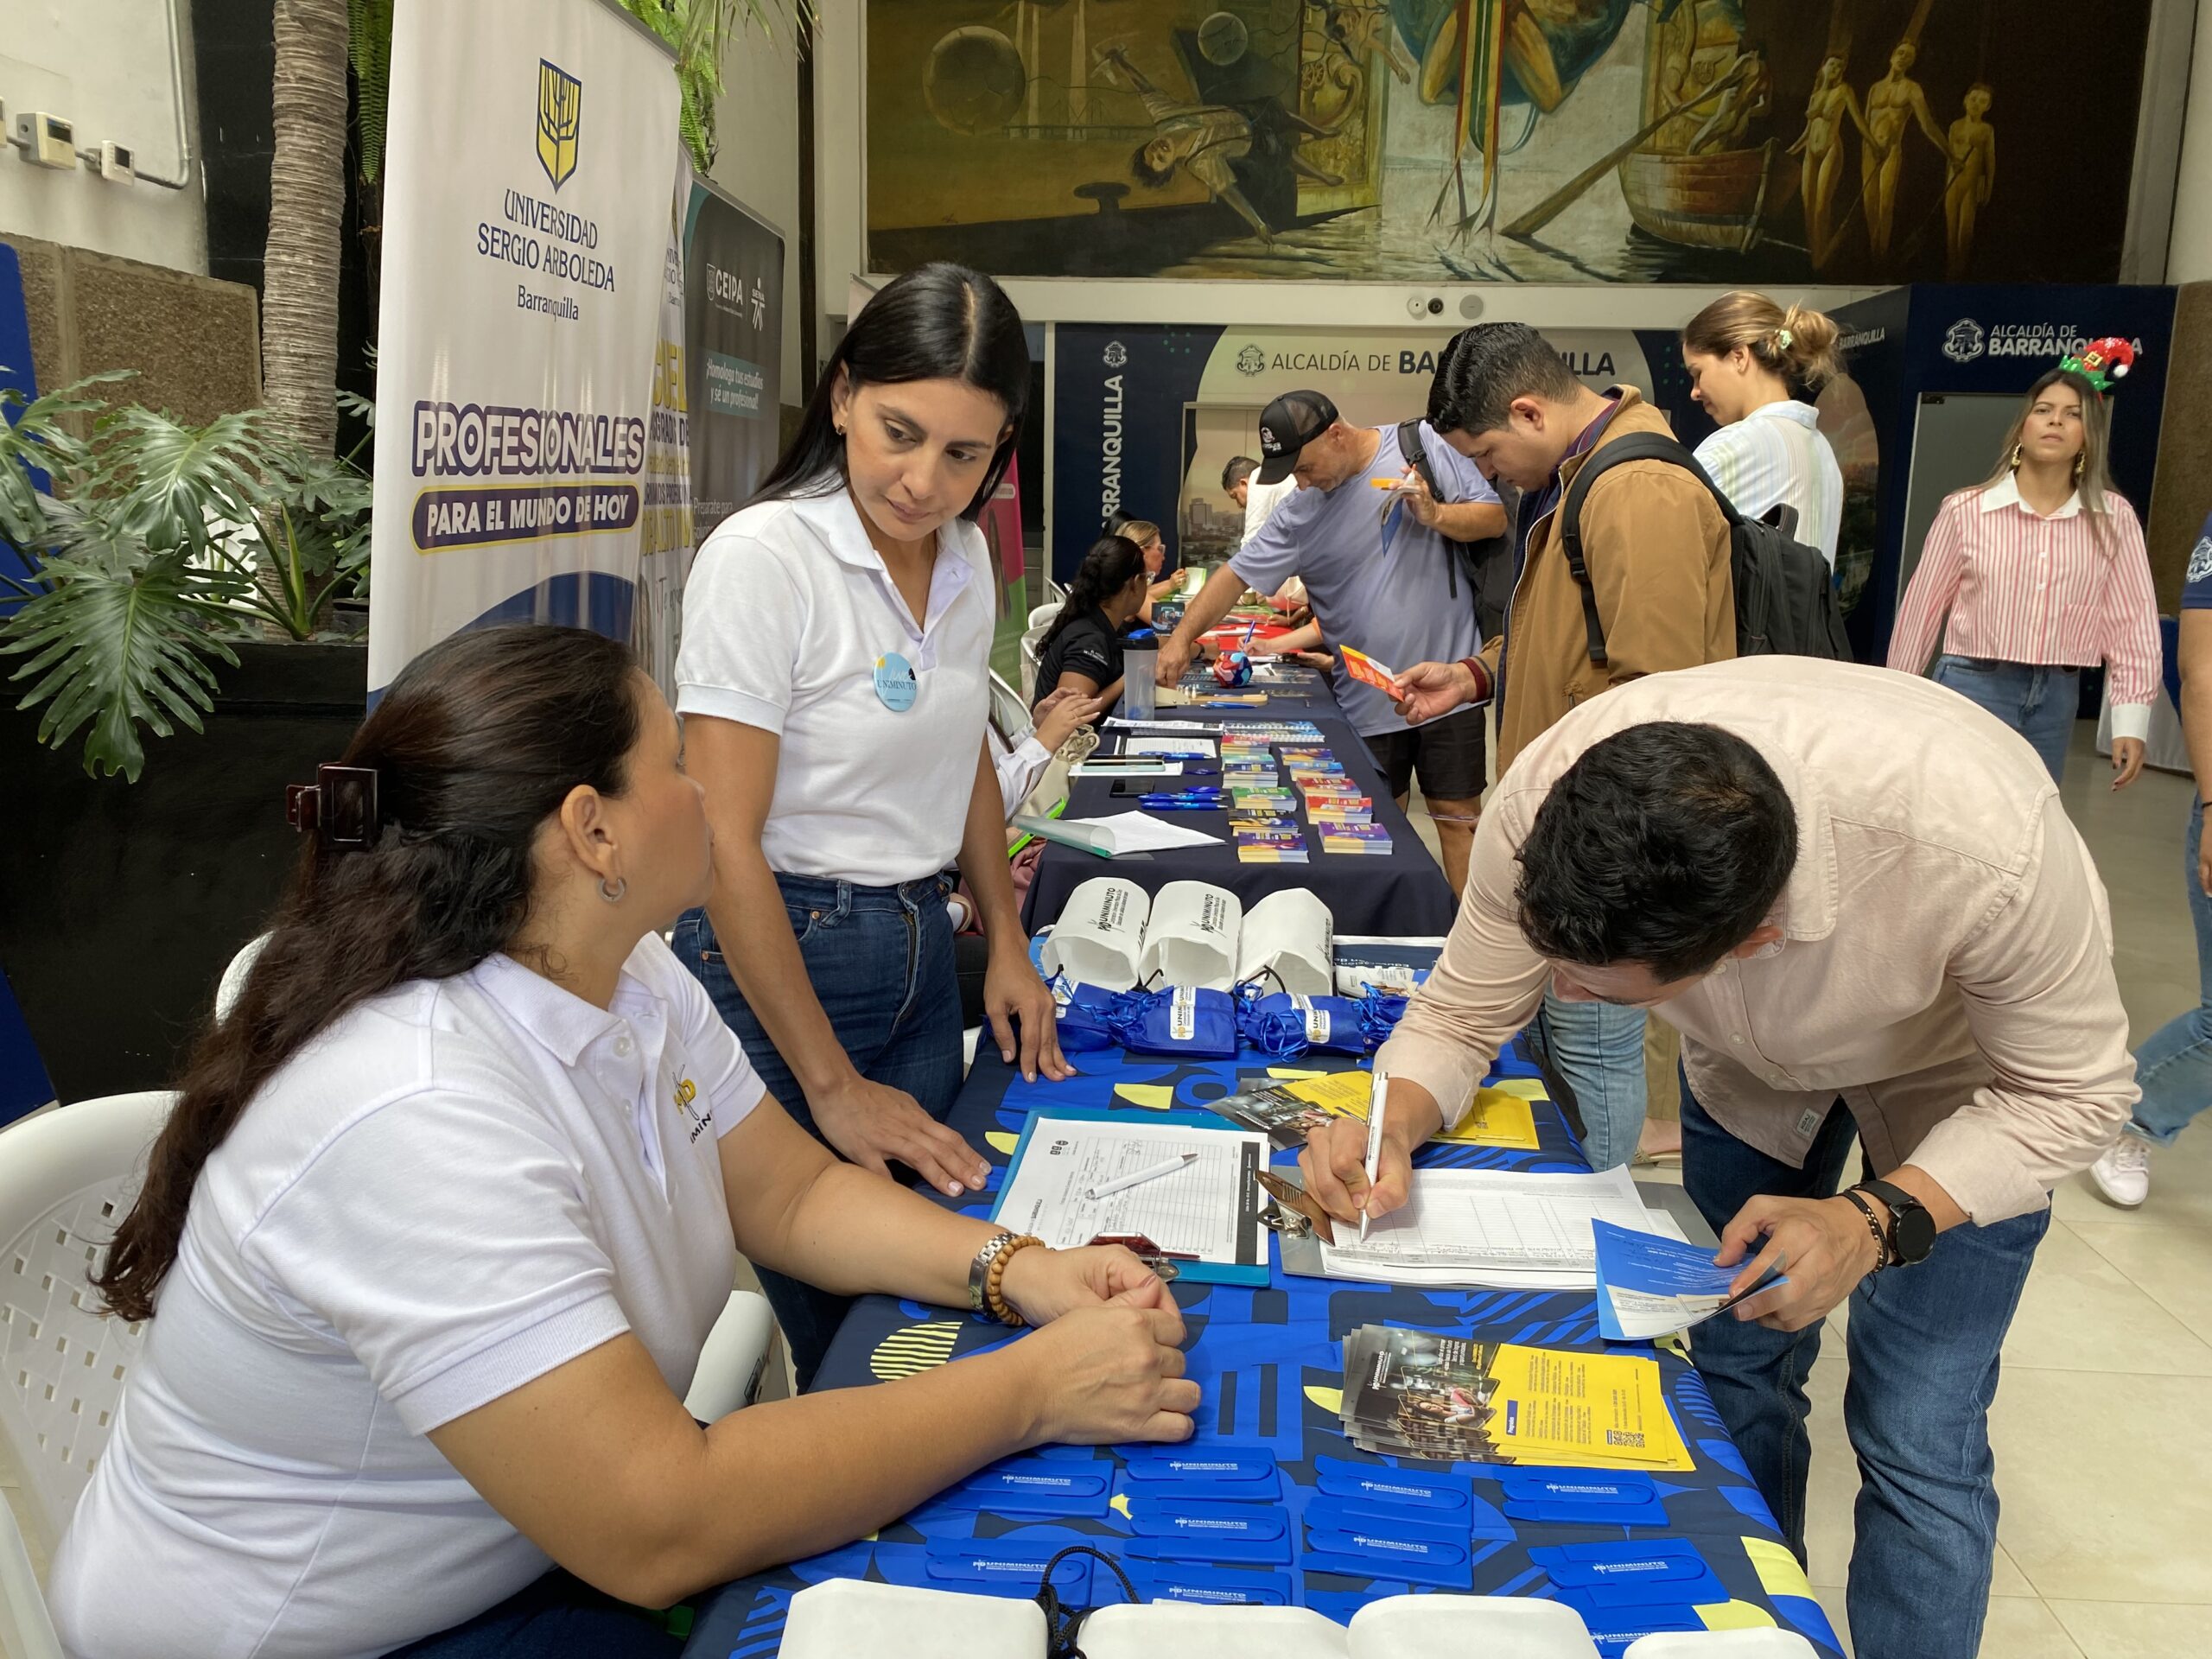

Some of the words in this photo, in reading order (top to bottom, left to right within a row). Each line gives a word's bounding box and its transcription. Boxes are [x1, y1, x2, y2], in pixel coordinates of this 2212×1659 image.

[505, 188, 598, 250] UNIVERSIDAD
[477, 222, 540, 270] SERGIO
[543, 245, 615, 293] ARBOLEDA
[518, 284, 579, 323] Barranquilla
[715, 269, 744, 306] CEIPA
[1990, 321, 2056, 338] ALCALDÍA
[2060, 325, 2078, 338] DE
[1271, 349, 1360, 372] ALCALDÍA
[1368, 353, 1391, 372] DE
[414, 405, 645, 473] PROFESIONALES
[427, 501, 481, 537] PARA
[486, 499, 505, 531] EL
[509, 495, 571, 531] MUNDO
[575, 494, 591, 524] DE
[594, 493, 629, 523] HOY
[1099, 887, 1116, 922] UNIMINUTO
